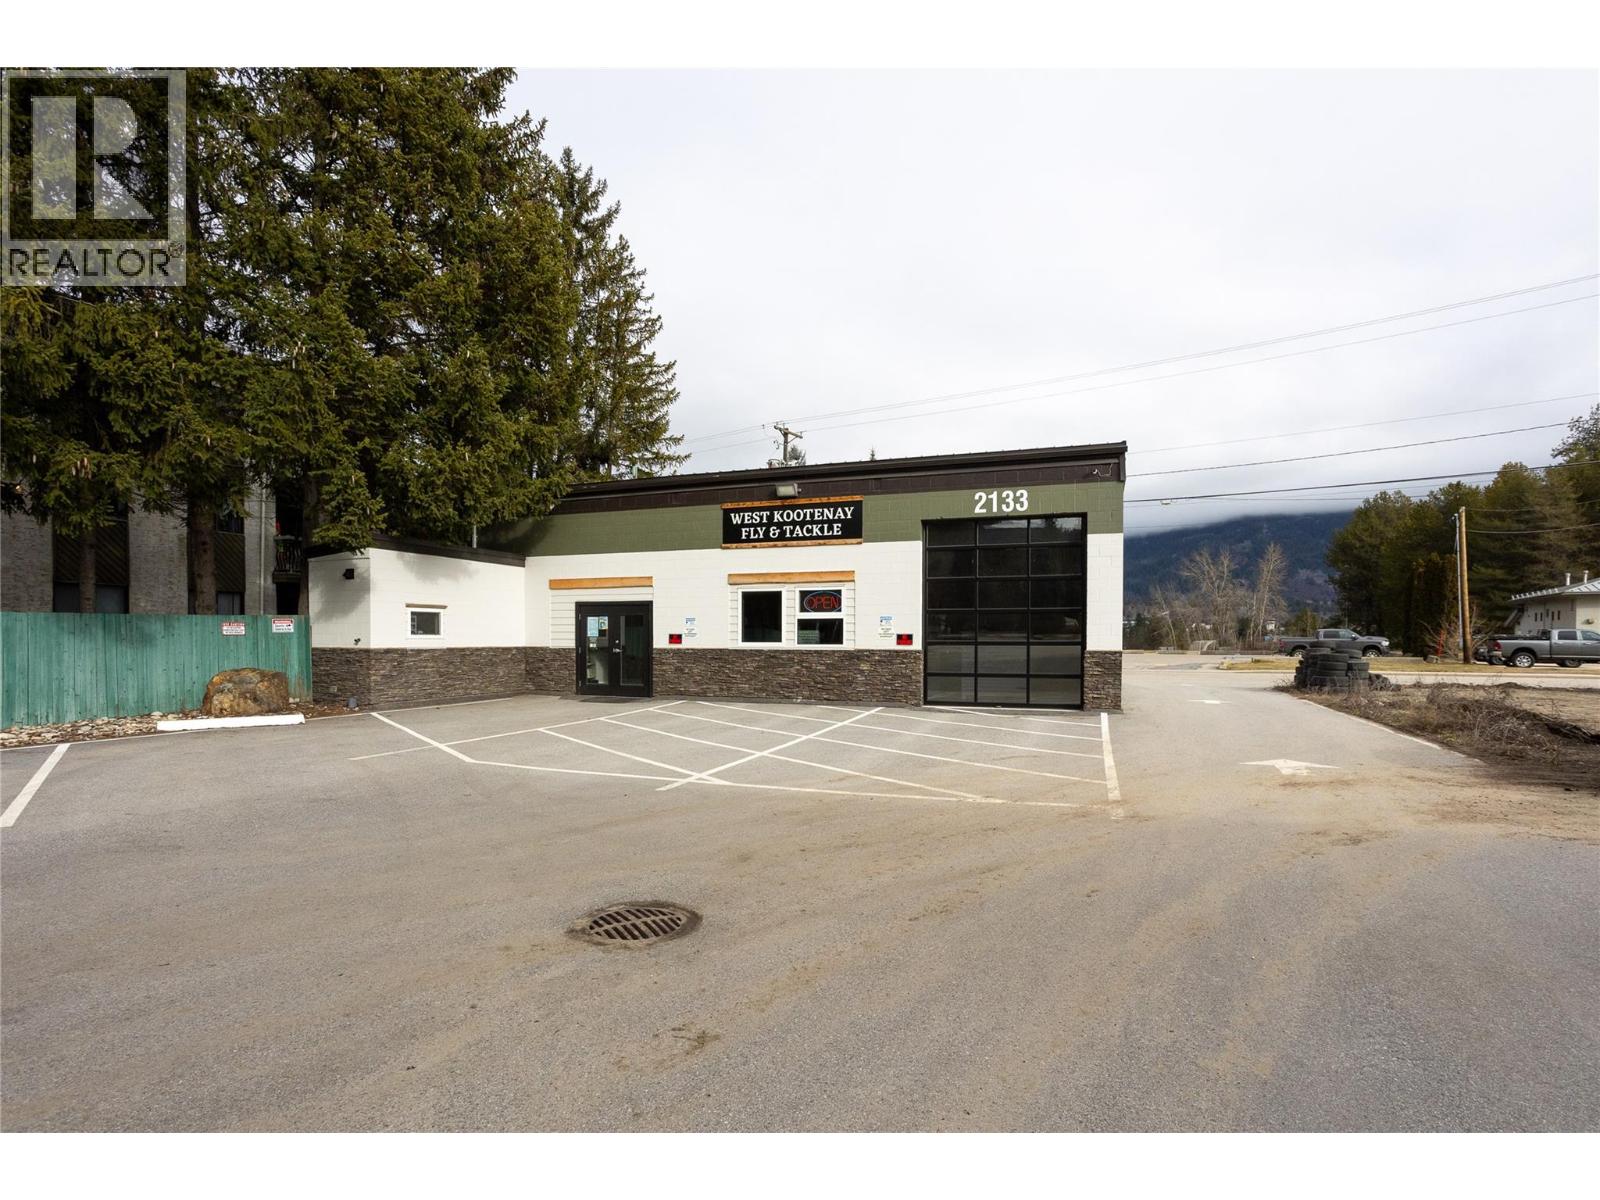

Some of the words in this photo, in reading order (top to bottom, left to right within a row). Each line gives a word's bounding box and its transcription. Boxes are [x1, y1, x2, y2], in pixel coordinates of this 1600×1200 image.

[974, 489, 1029, 513] 2133
[730, 510, 769, 525] WEST
[773, 506, 854, 523] KOOTENAY
[741, 526, 766, 540] FLY
[769, 526, 781, 538] &
[783, 523, 842, 538] TACKLE
[805, 595, 839, 609] OPEN
